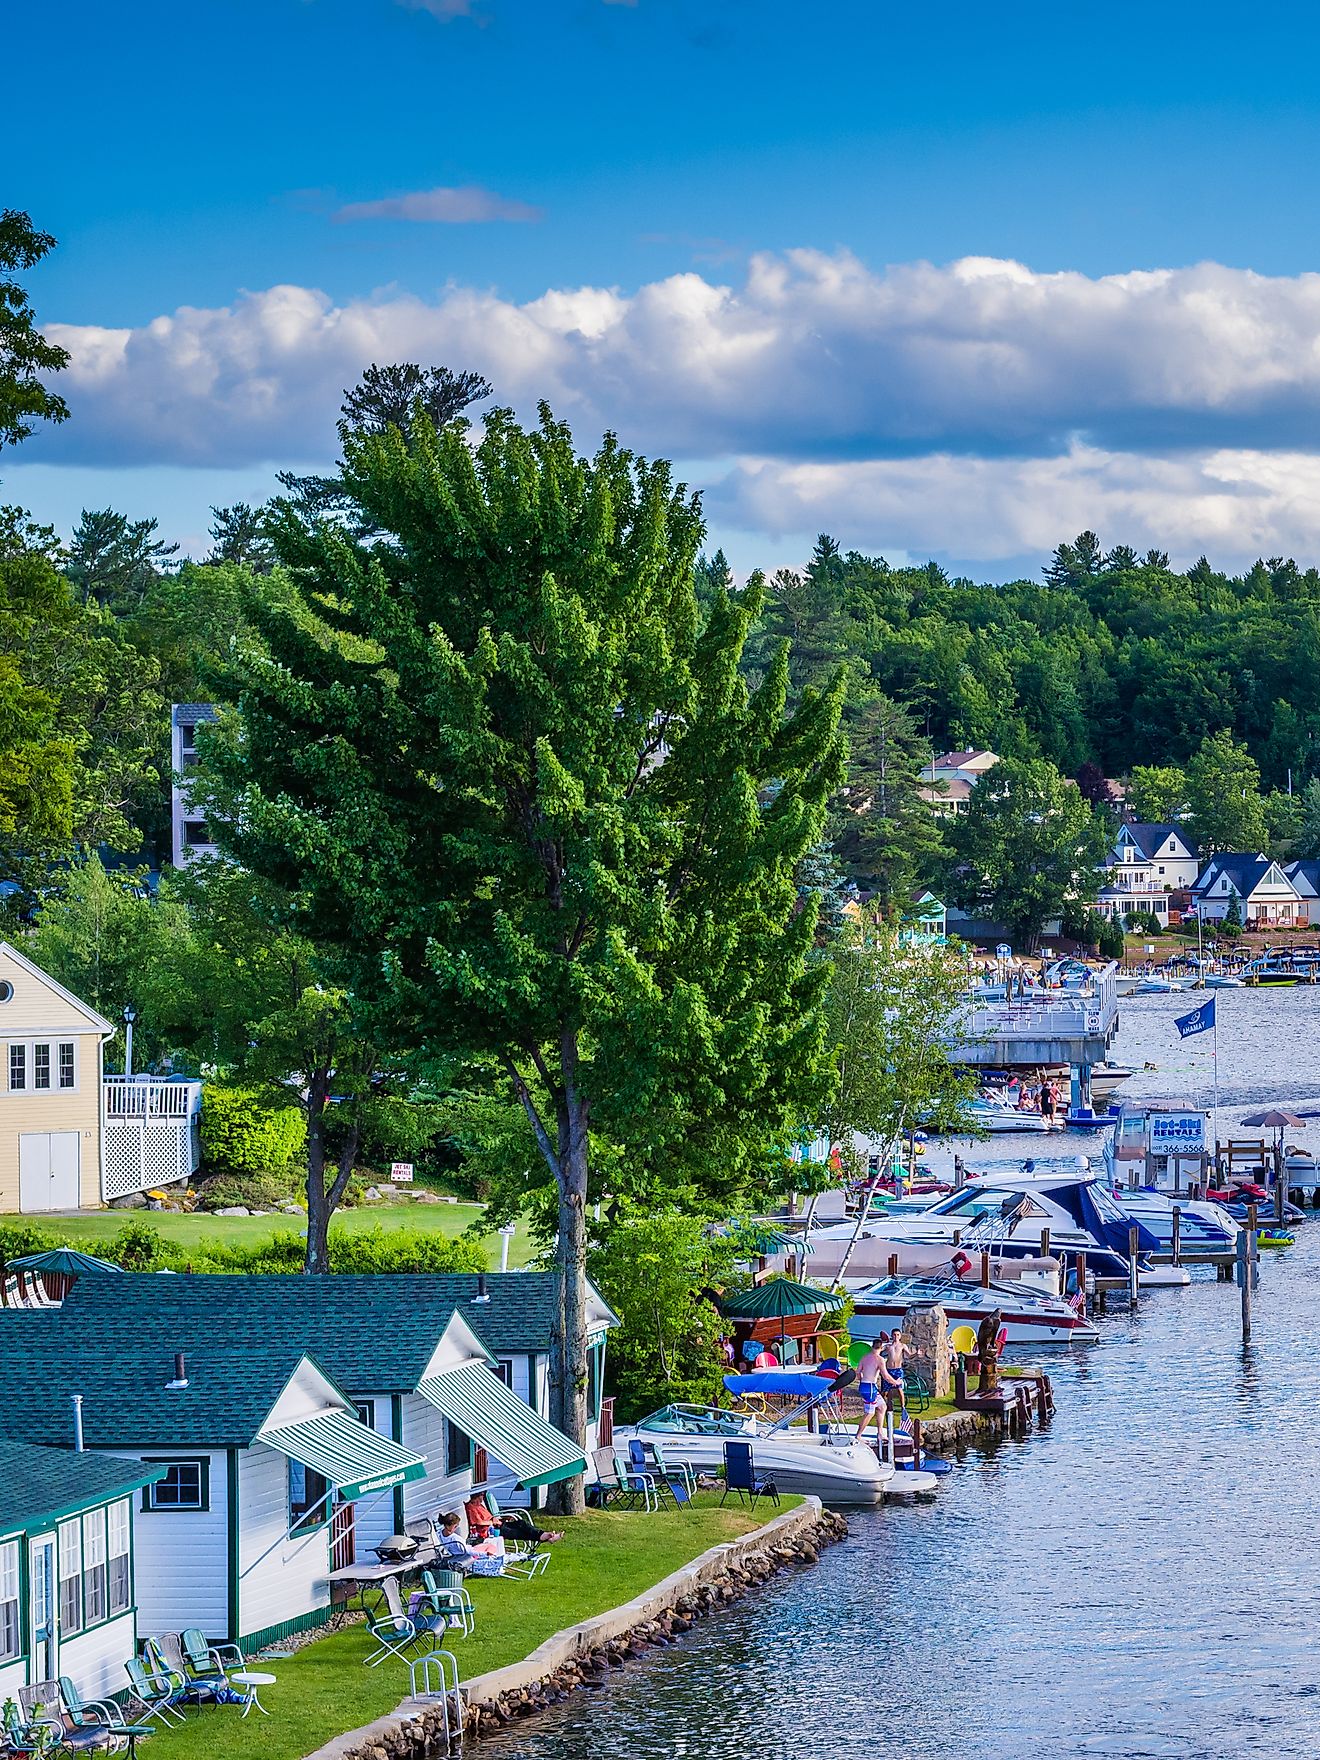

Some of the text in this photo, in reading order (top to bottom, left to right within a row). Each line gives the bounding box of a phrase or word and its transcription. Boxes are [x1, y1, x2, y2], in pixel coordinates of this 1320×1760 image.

[1153, 1118, 1202, 1129] Jet-Ski
[1153, 1129, 1202, 1137] RENTALS
[1163, 1144, 1205, 1153] 366-5566
